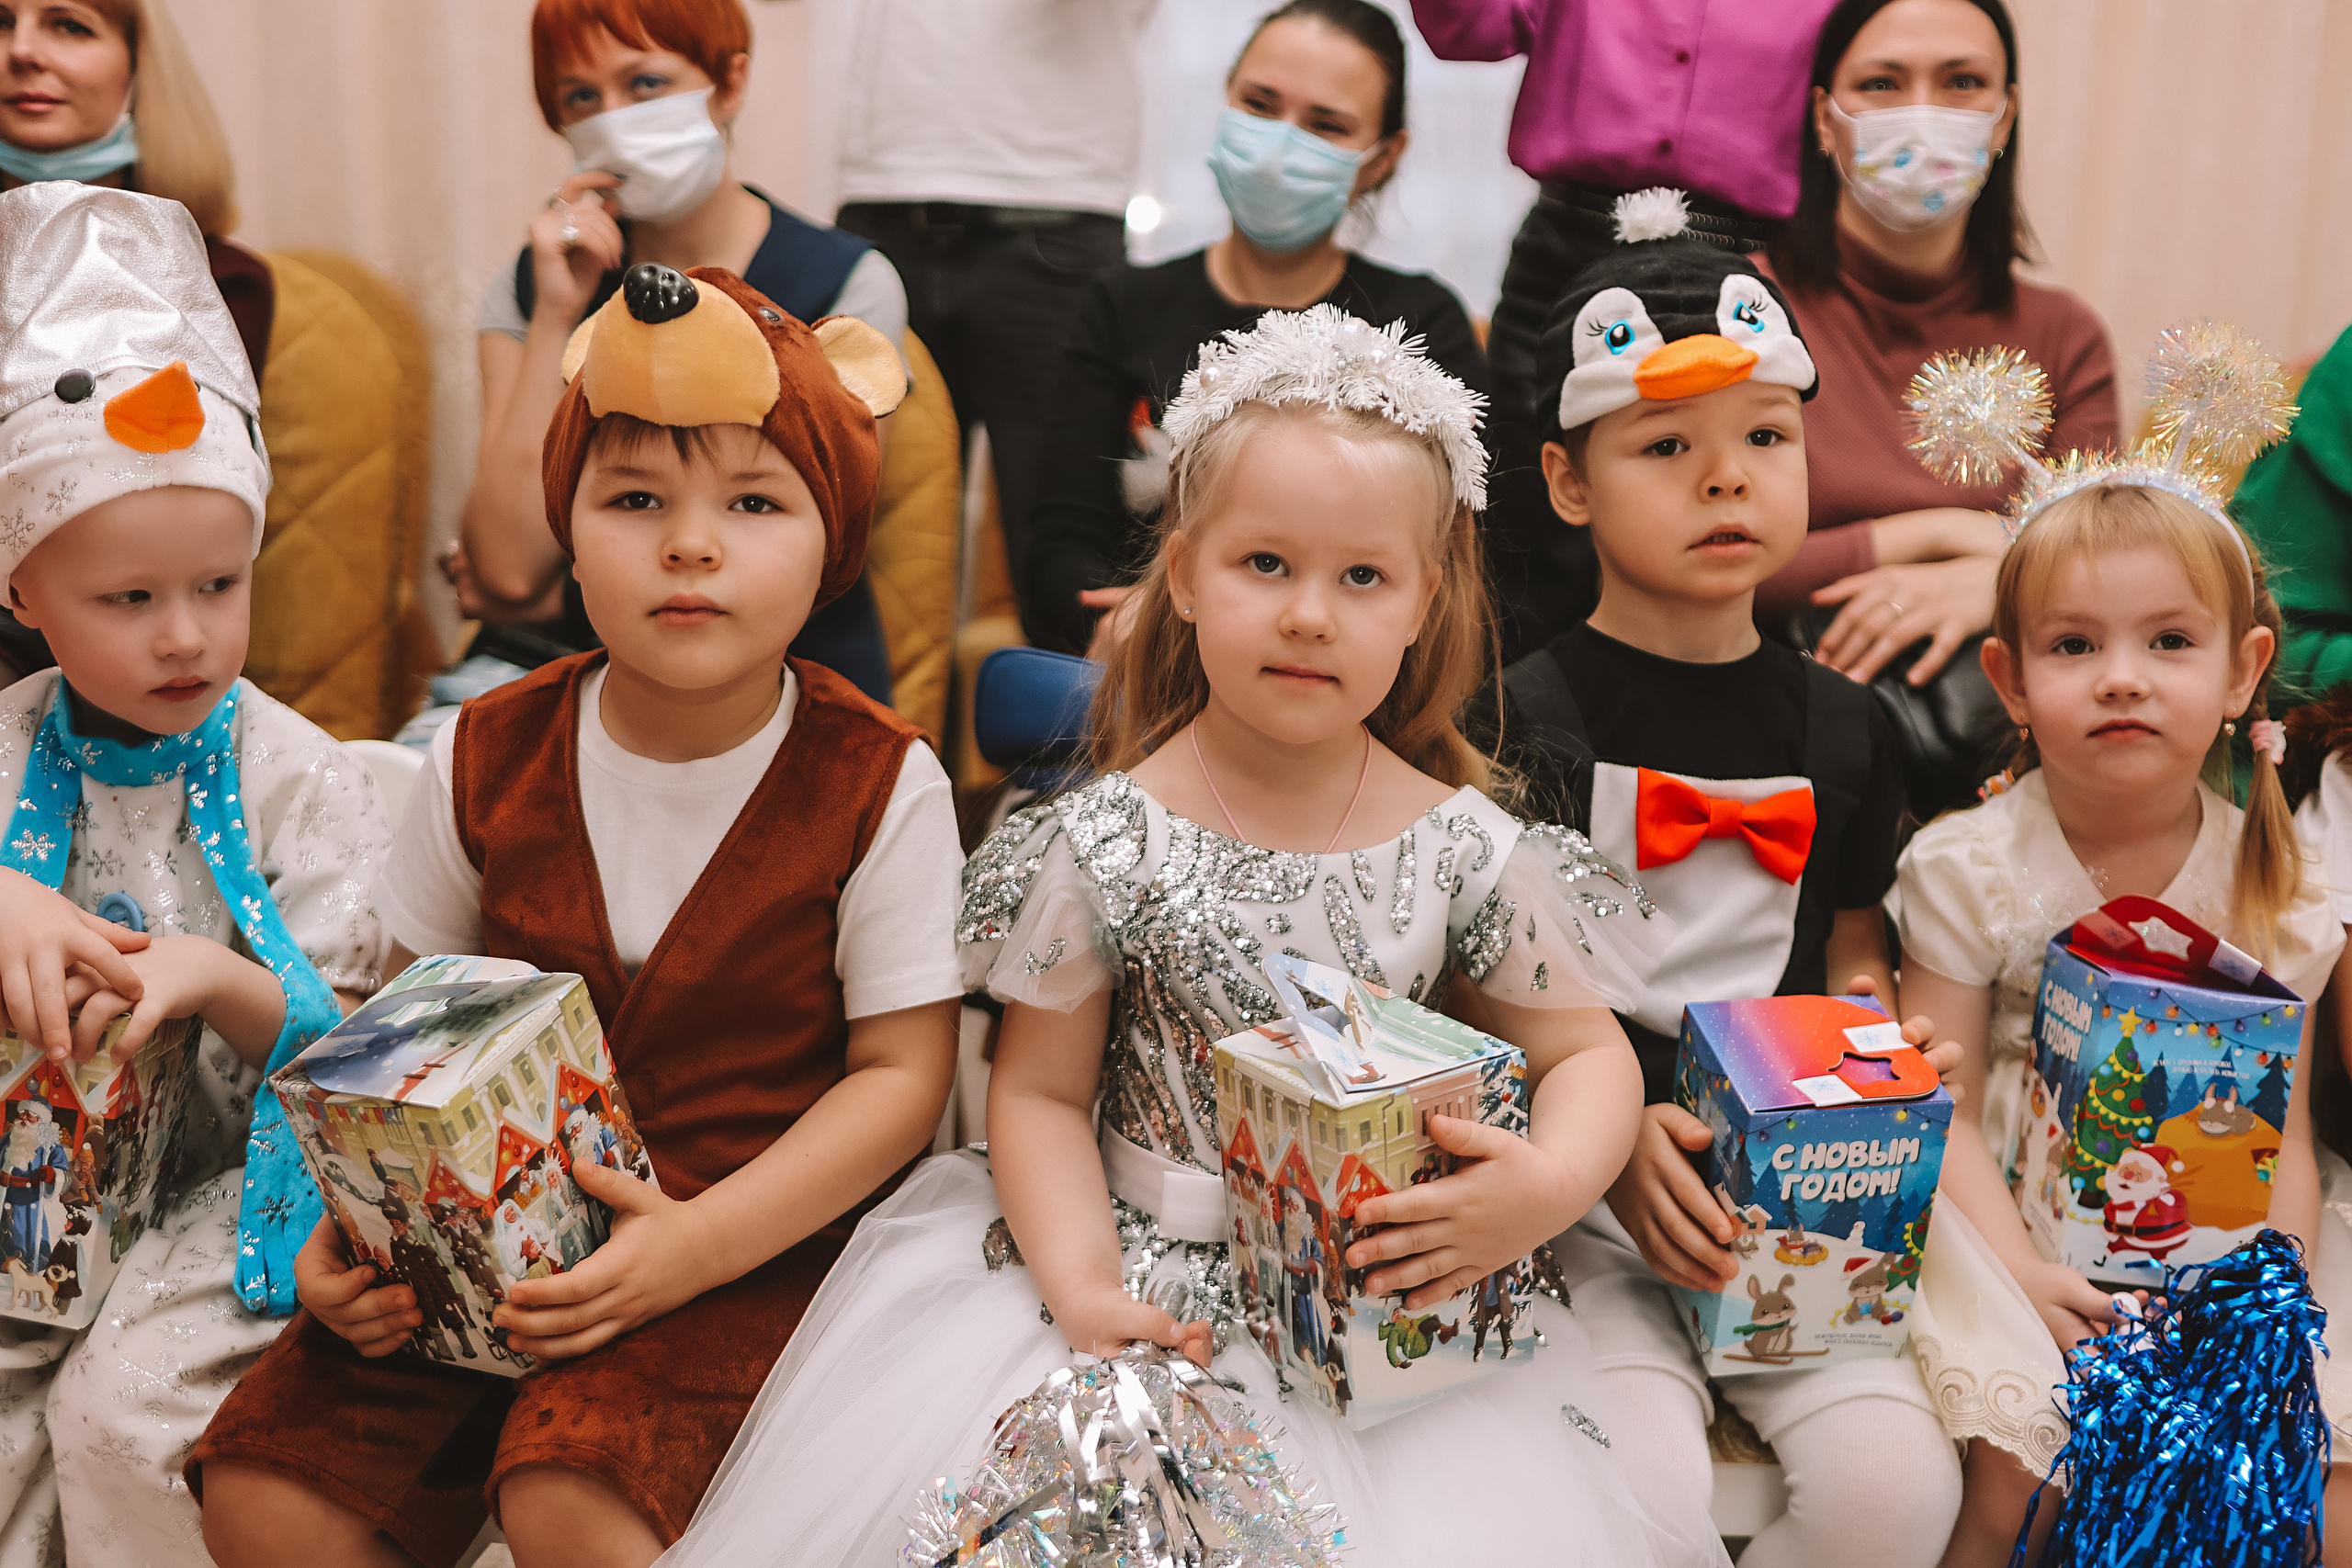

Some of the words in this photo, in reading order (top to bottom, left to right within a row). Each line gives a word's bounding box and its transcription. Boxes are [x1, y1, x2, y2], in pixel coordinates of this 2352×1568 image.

[2044, 979, 2053, 1007] С
[2051, 984, 2093, 1033] НОВЫМ
[1772, 1143, 1795, 1170] С
[1800, 1137, 1920, 1170] НОВЫМ
[1781, 1168, 1902, 1202] ГОДОМ!
